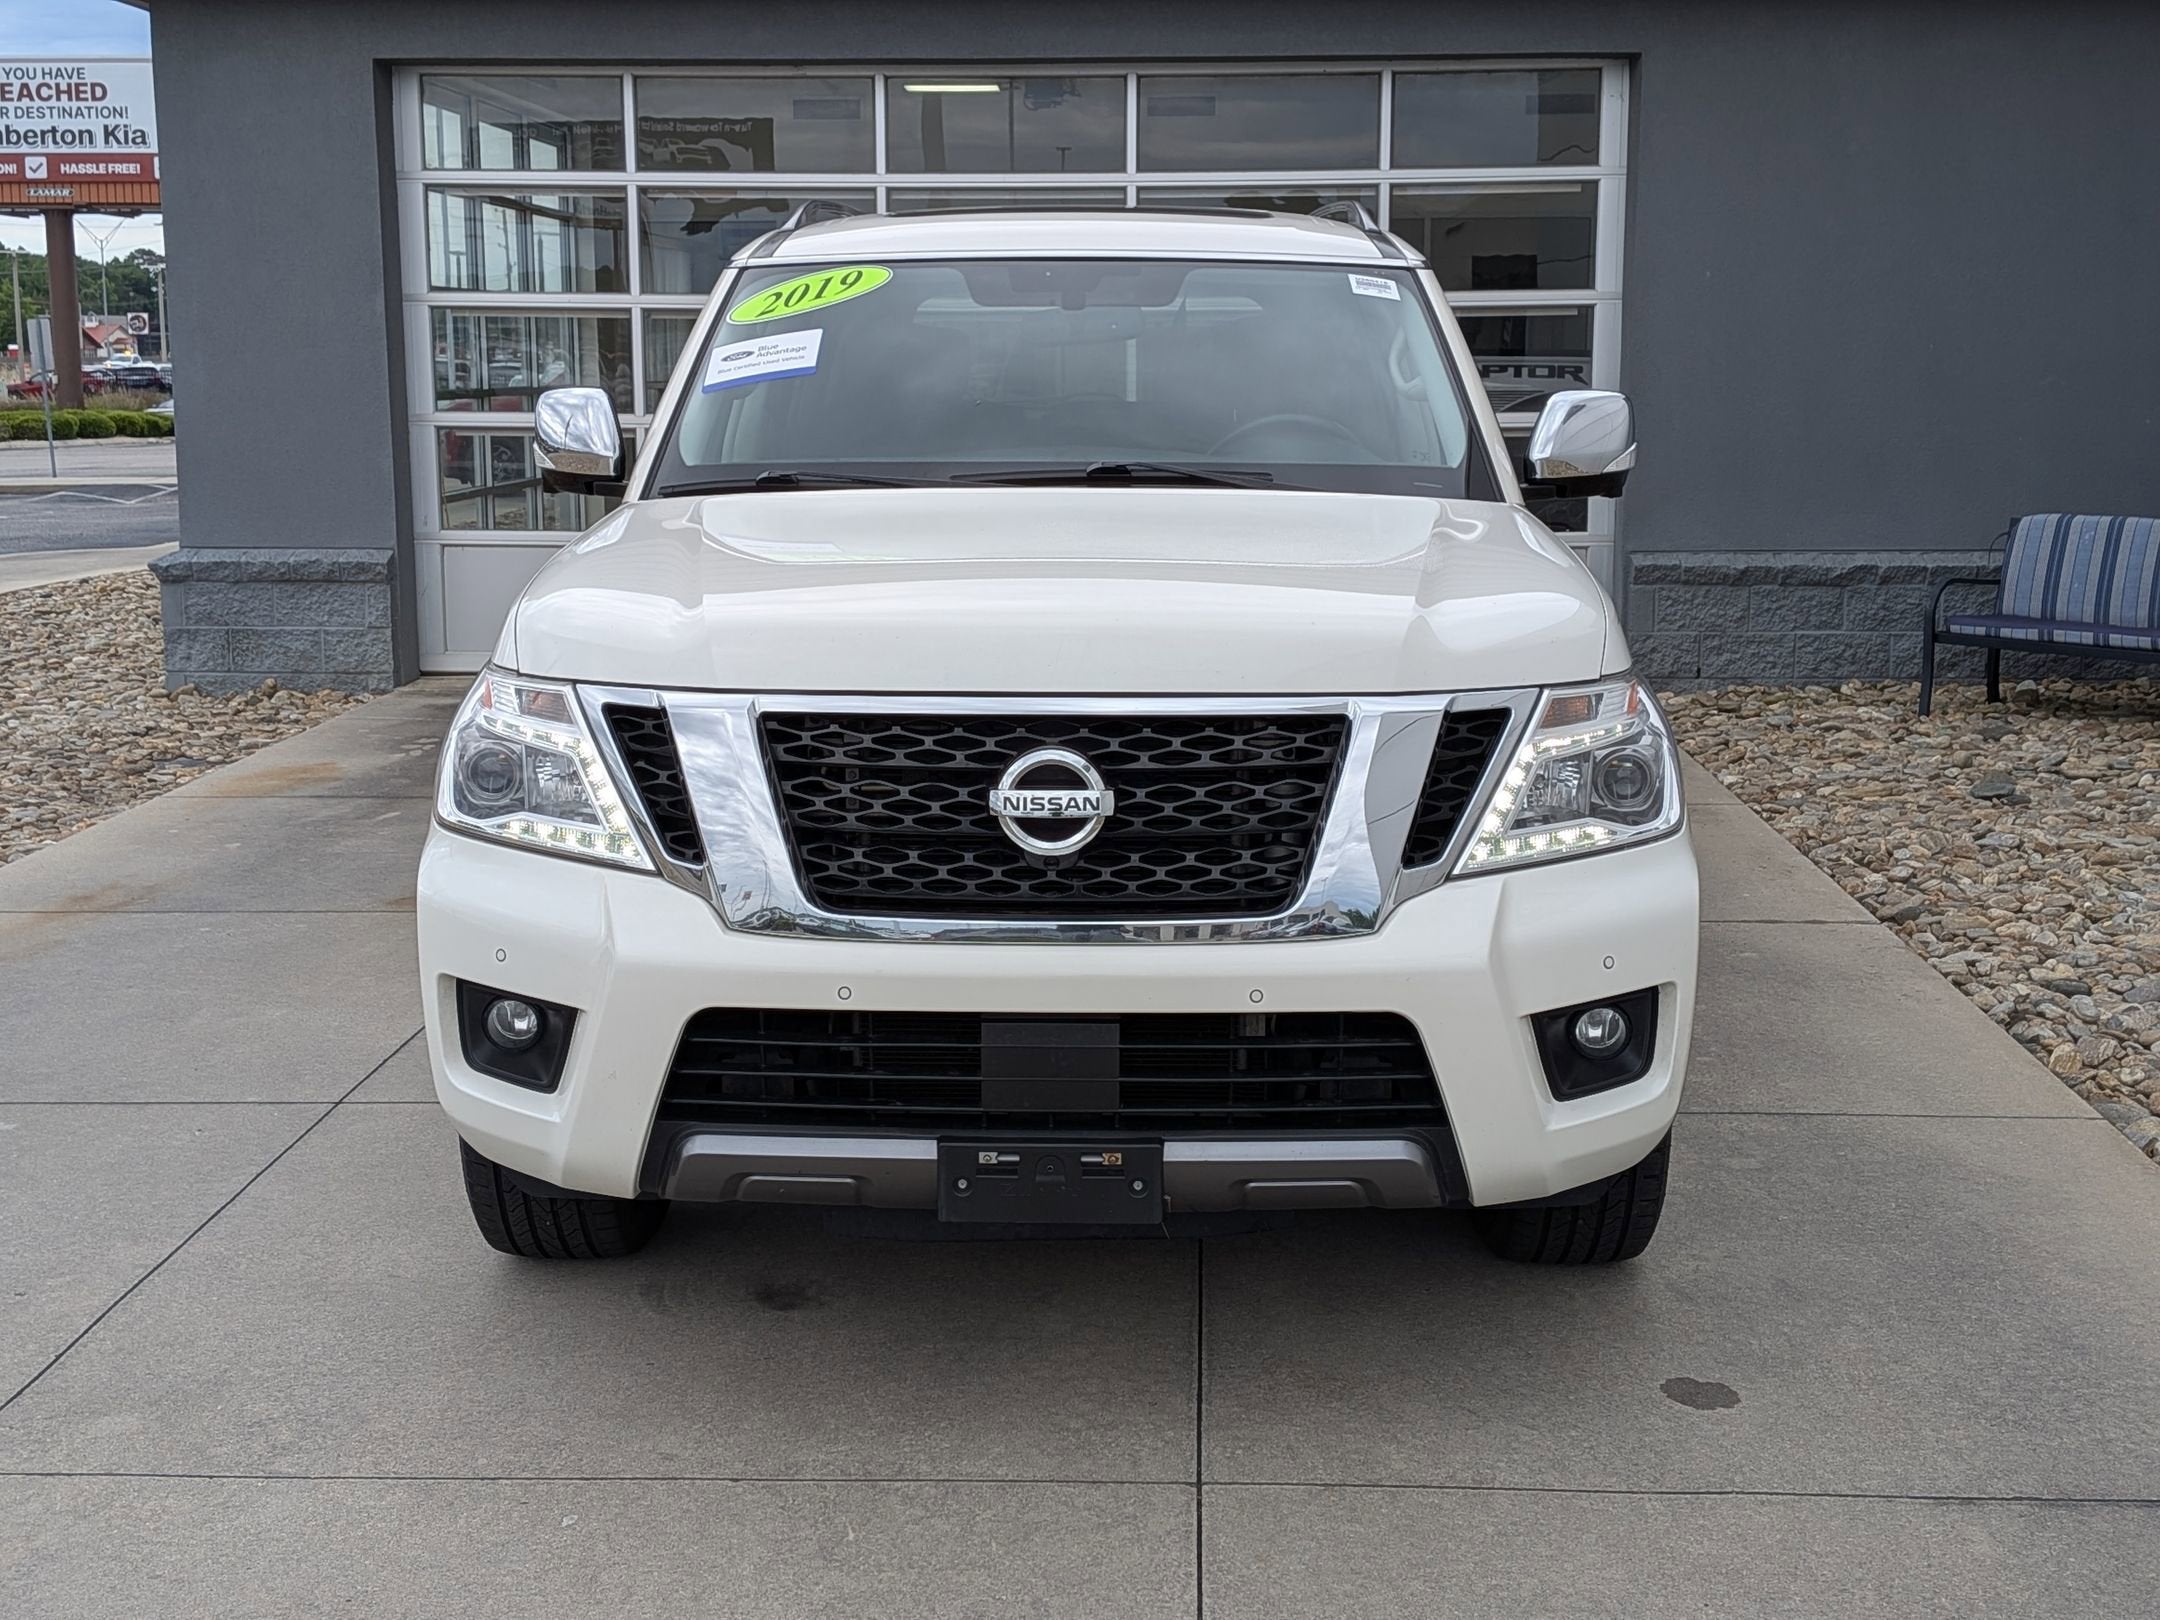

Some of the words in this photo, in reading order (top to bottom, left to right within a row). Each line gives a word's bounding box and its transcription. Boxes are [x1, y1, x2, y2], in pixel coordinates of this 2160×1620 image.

[2, 67, 37, 80] YOU
[41, 67, 86, 80] HAVE
[0, 82, 108, 102] EACHED
[0, 106, 10, 119] R
[14, 106, 129, 119] DESTINATION!
[103, 124, 149, 146] Kia
[0, 163, 17, 175] ON!
[60, 163, 107, 174] HASSLE
[108, 163, 141, 174] FREE!
[755, 270, 864, 318] 2019
[756, 345, 808, 358] Advantage
[757, 344, 780, 352] Blue
[1478, 364, 1589, 386] PTOR
[1002, 796, 1101, 812] NISSAN
